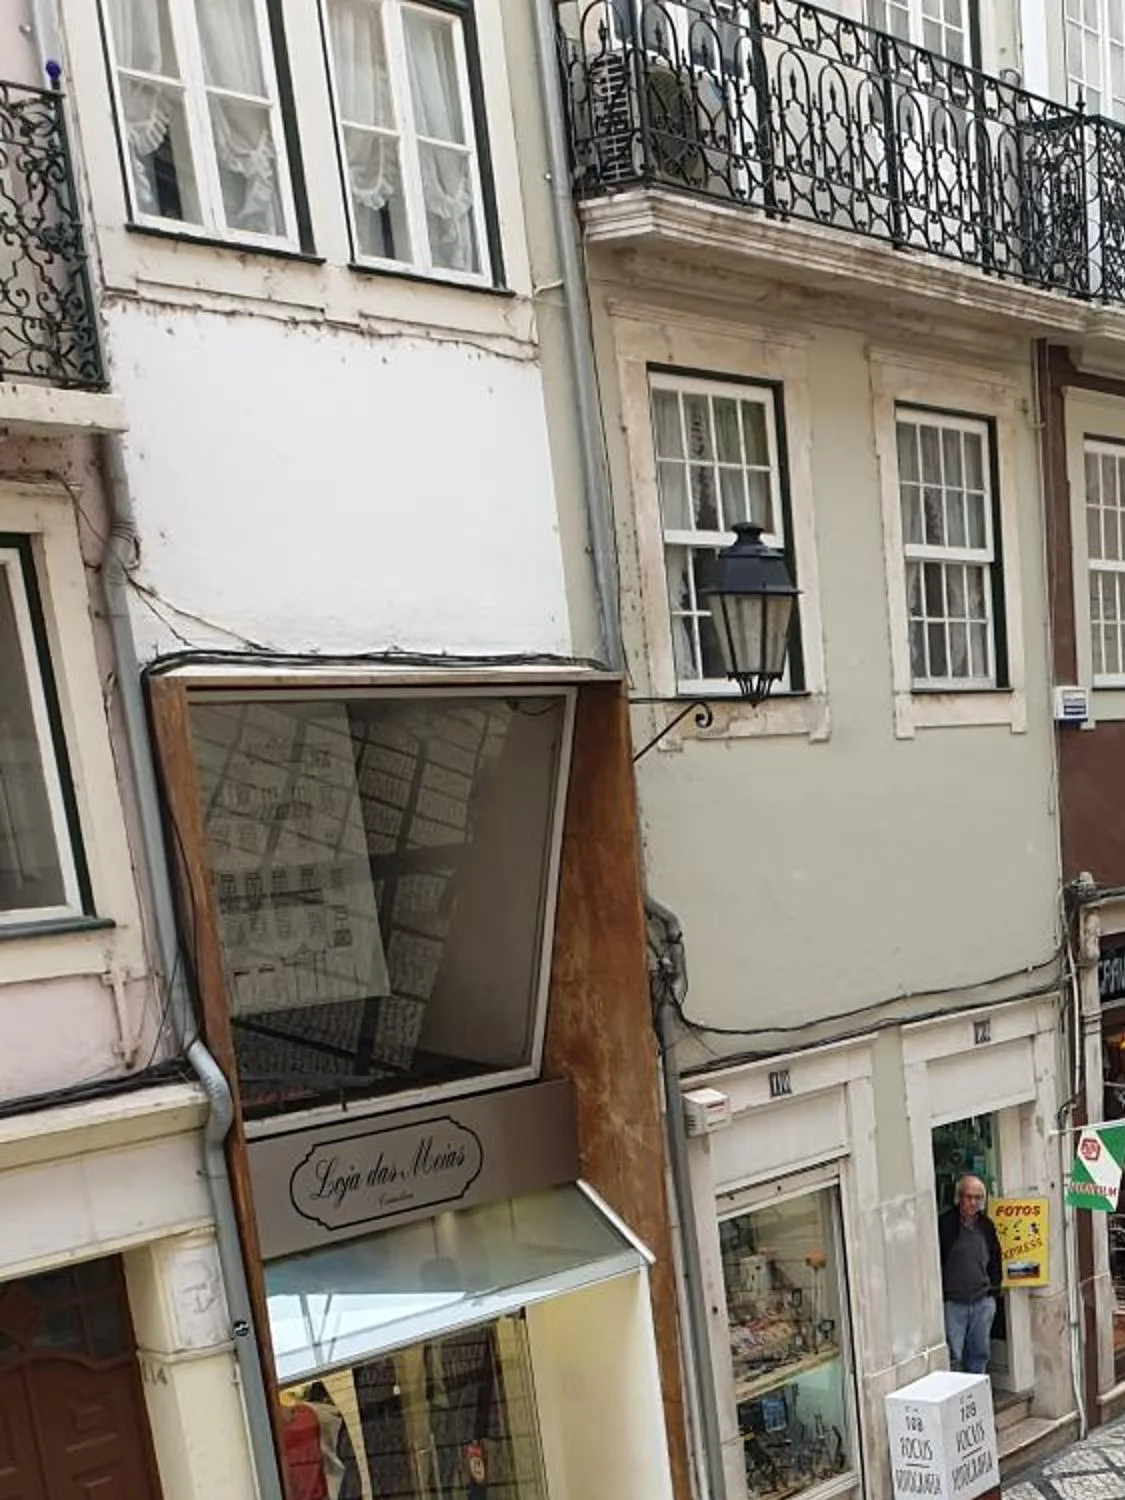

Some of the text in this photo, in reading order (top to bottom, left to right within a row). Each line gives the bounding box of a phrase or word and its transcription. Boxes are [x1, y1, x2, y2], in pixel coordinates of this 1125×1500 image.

[310, 1156, 361, 1210] Loja
[366, 1152, 398, 1187] das
[400, 1135, 466, 1180] Meias
[995, 1205, 1041, 1217] FOTOS
